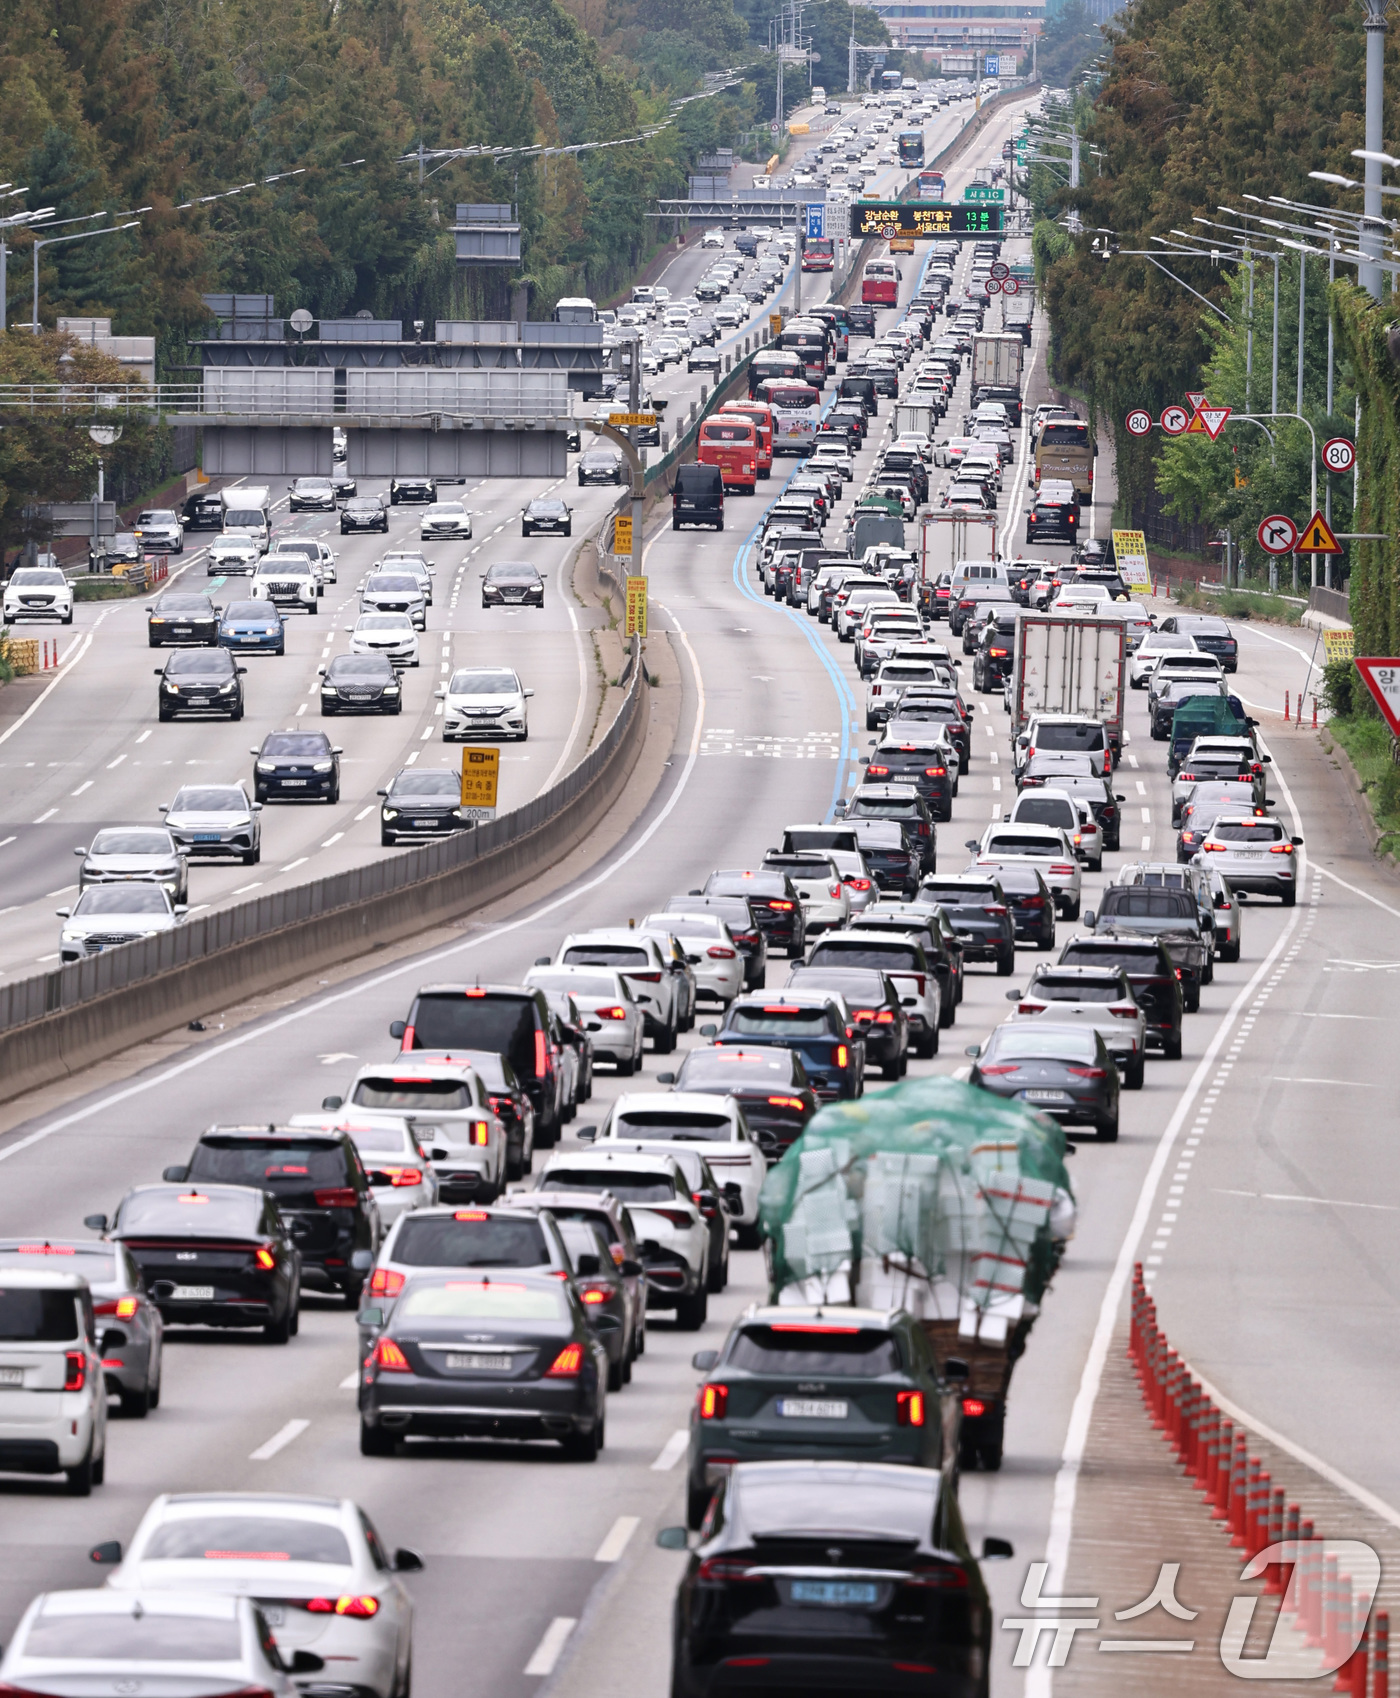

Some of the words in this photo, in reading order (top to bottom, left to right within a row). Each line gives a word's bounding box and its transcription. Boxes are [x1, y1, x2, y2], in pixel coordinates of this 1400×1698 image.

[864, 210, 900, 221] 강남순환
[913, 210, 952, 222] 봉천T출구
[966, 212, 976, 221] 13
[980, 212, 990, 222] 분
[884, 228, 894, 236] 80
[915, 222, 950, 232] 서울대역
[966, 224, 976, 232] 17
[988, 282, 998, 290] 80
[1005, 282, 1016, 290] 30
[1131, 416, 1147, 430] 80
[1330, 447, 1350, 465] 80
[1070, 464, 1088, 474] Gold
[1378, 670, 1395, 684] 양
[467, 809, 490, 818] 200m
